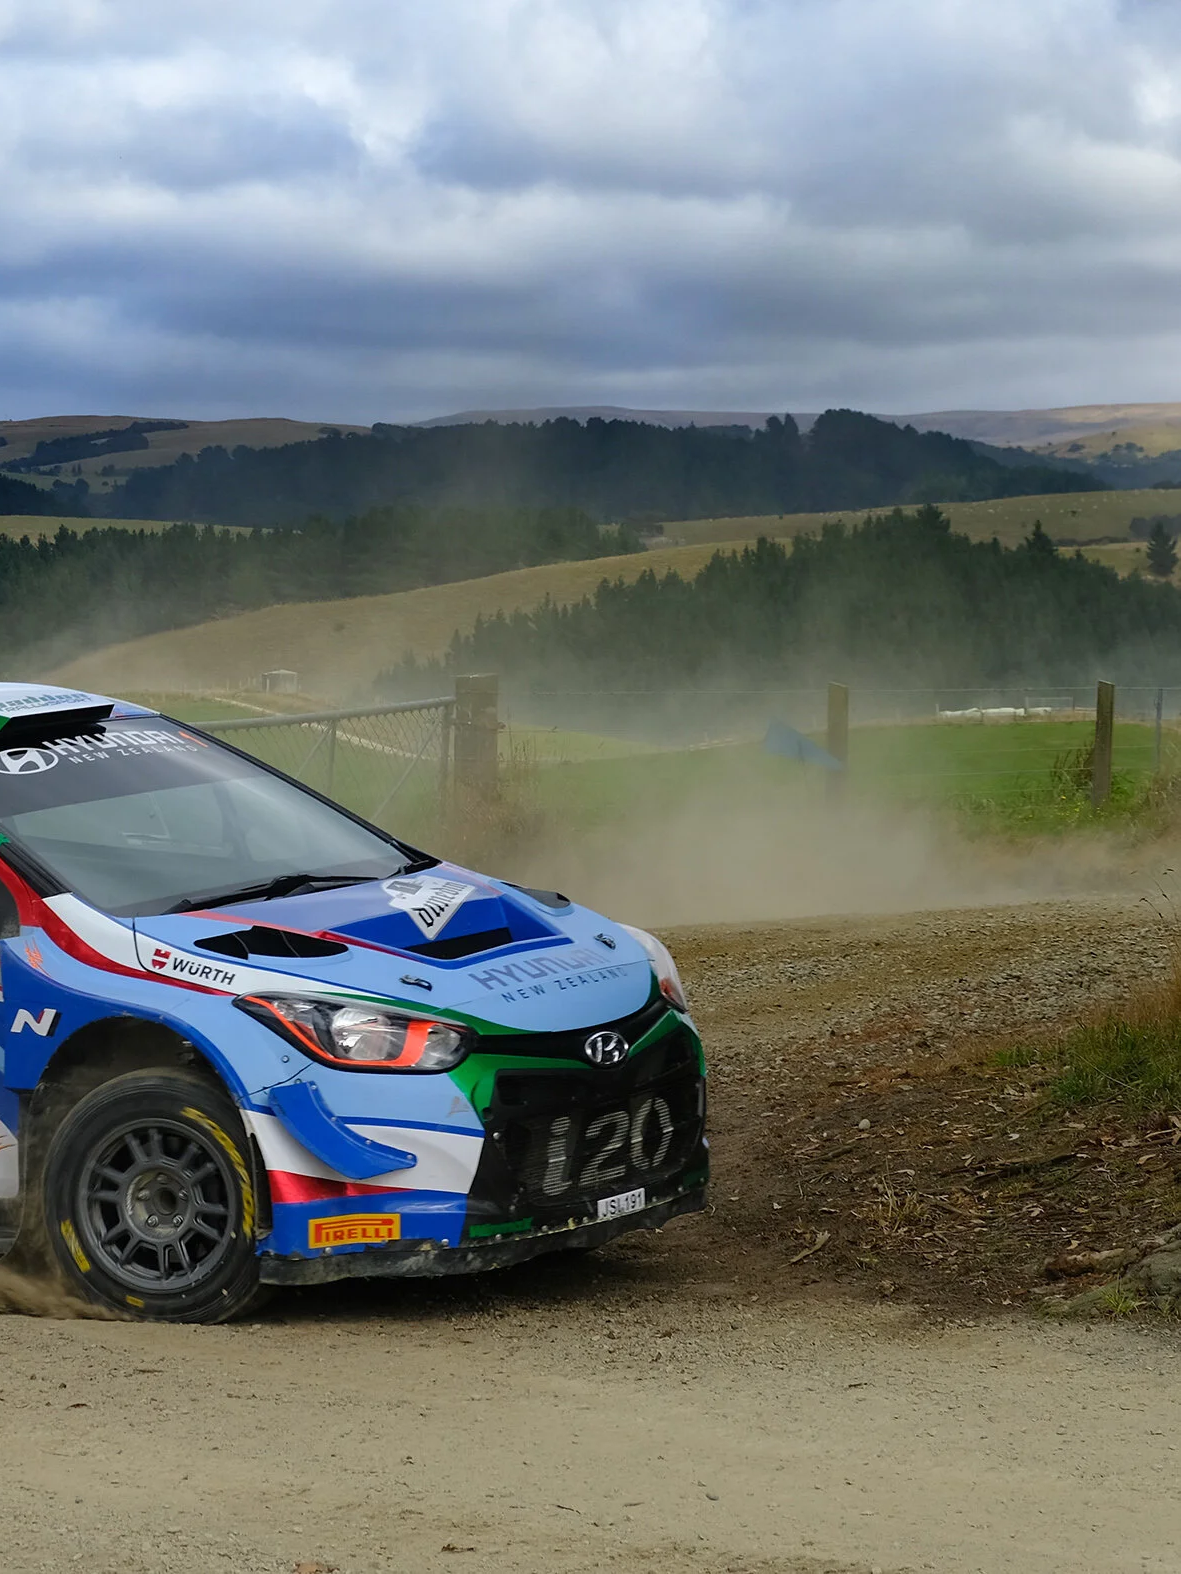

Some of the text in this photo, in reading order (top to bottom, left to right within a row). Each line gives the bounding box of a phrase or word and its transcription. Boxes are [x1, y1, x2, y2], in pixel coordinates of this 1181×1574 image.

[42, 731, 186, 756] HYUNDAI
[69, 745, 199, 764] NEW ZEALAND
[501, 967, 628, 1003] NEW ZEALAND
[314, 1218, 395, 1244] PIRELLI
